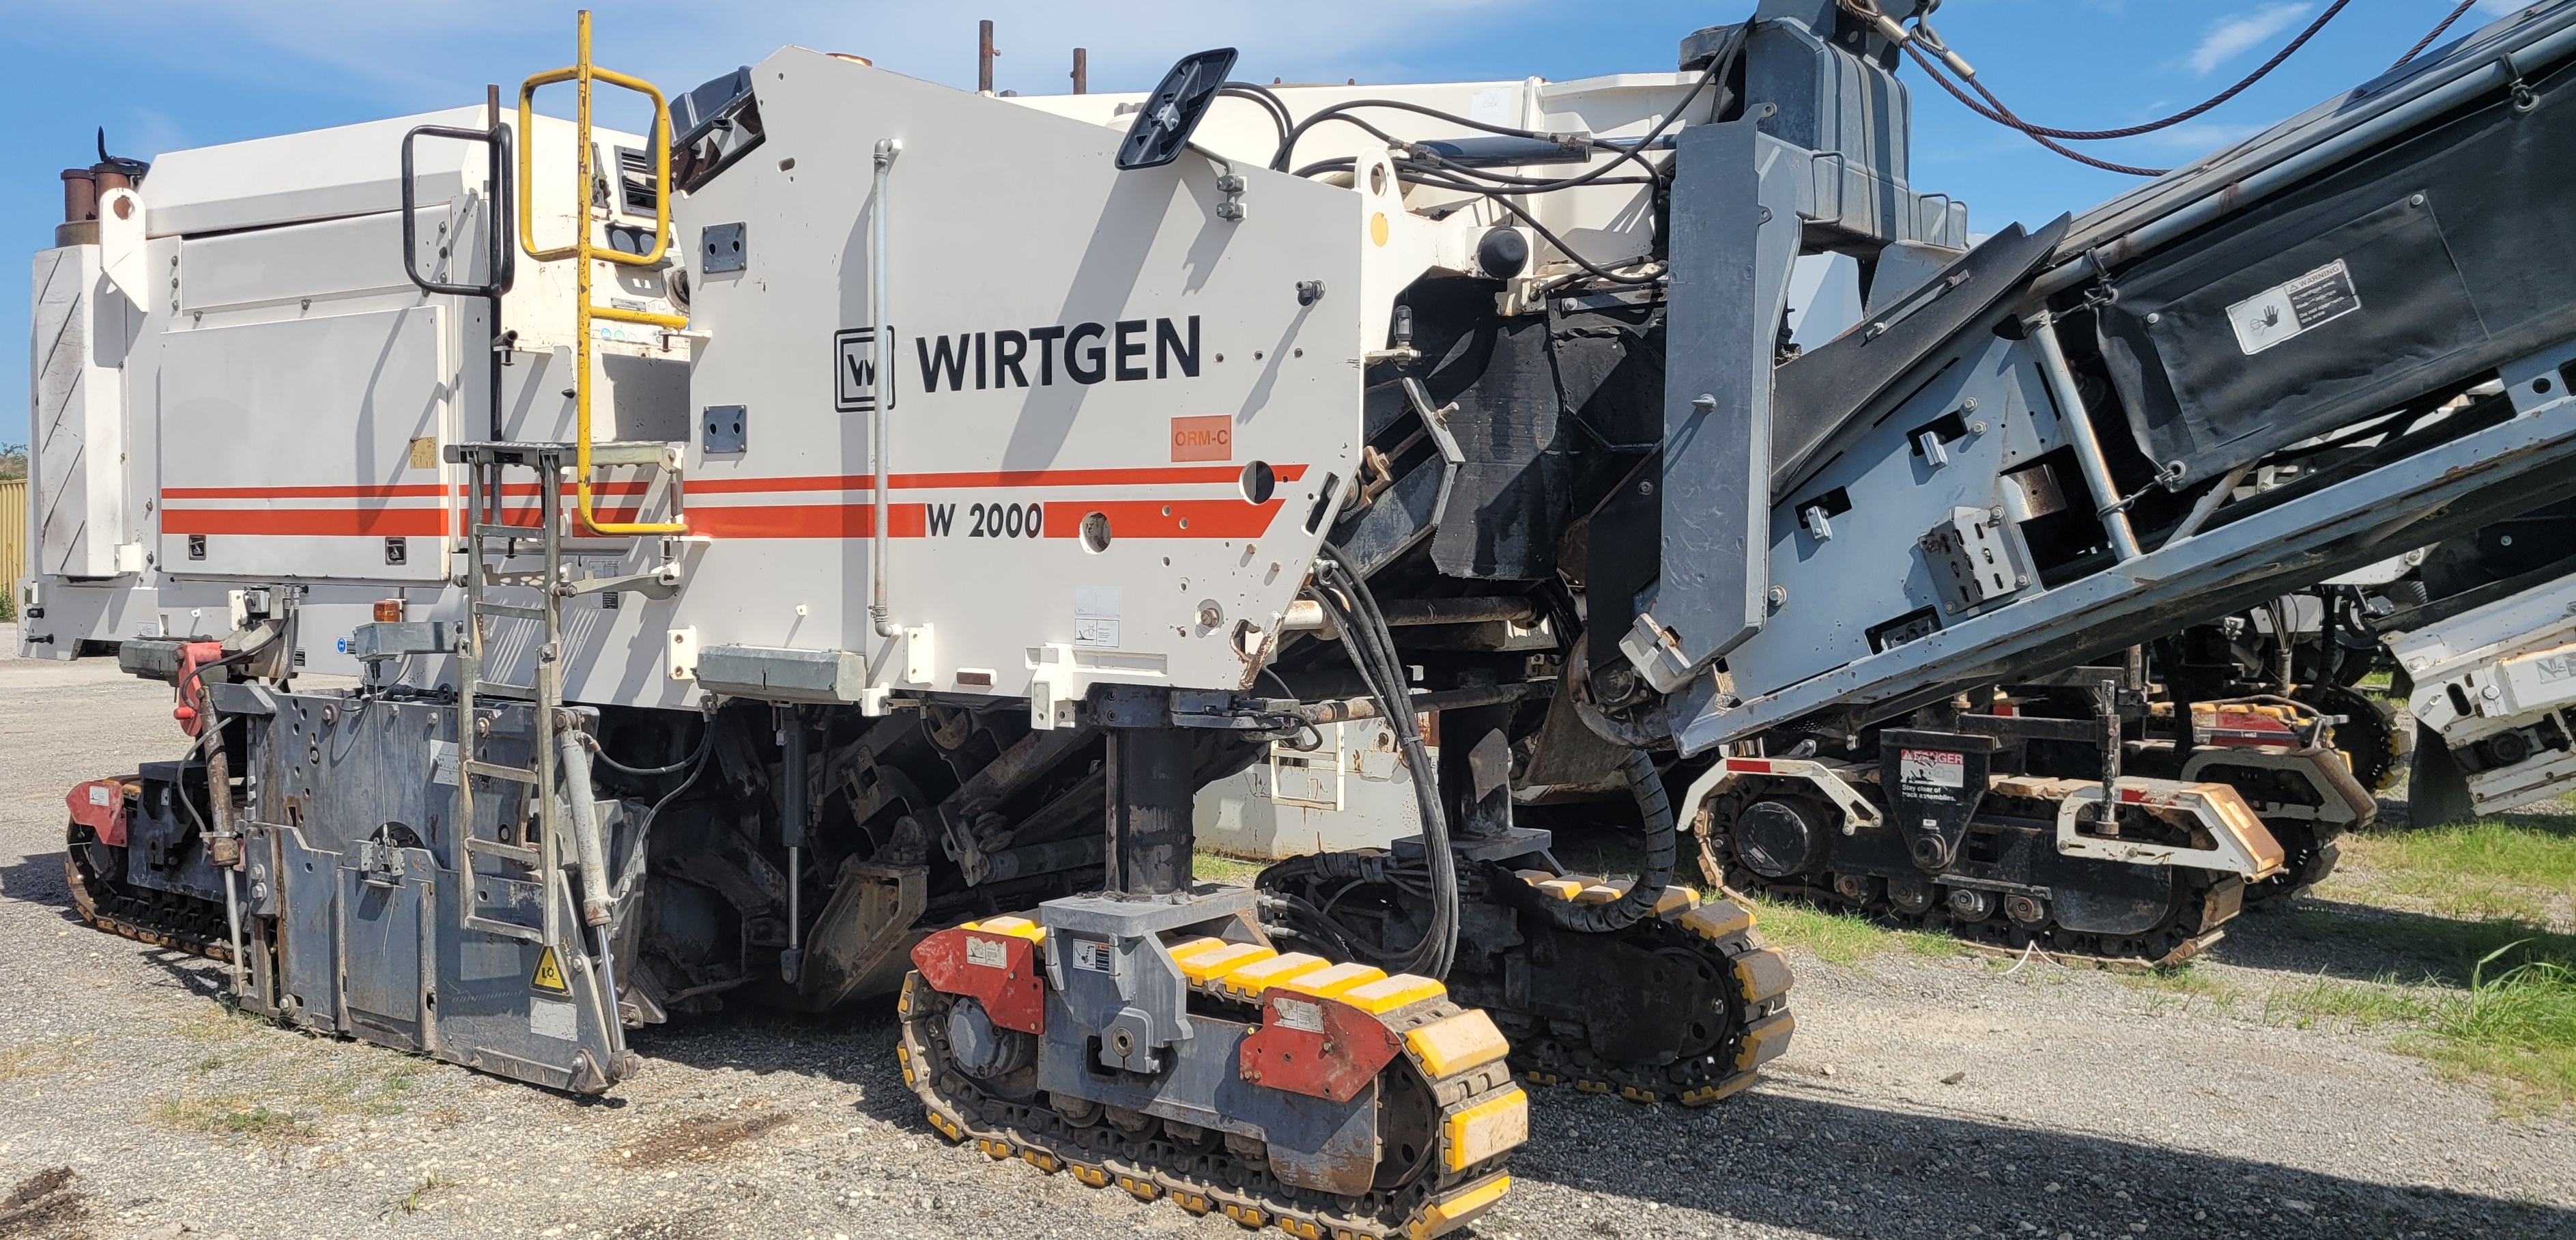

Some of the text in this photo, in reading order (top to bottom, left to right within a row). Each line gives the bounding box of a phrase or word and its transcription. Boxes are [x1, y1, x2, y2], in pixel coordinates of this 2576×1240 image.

[2299, 266, 2339, 287] WARNING
[915, 315, 1201, 393] WIRTGEN
[1175, 429, 1228, 446] ORM-C
[926, 503, 1042, 538] W 2000
[1902, 784, 1917, 792] Stay
